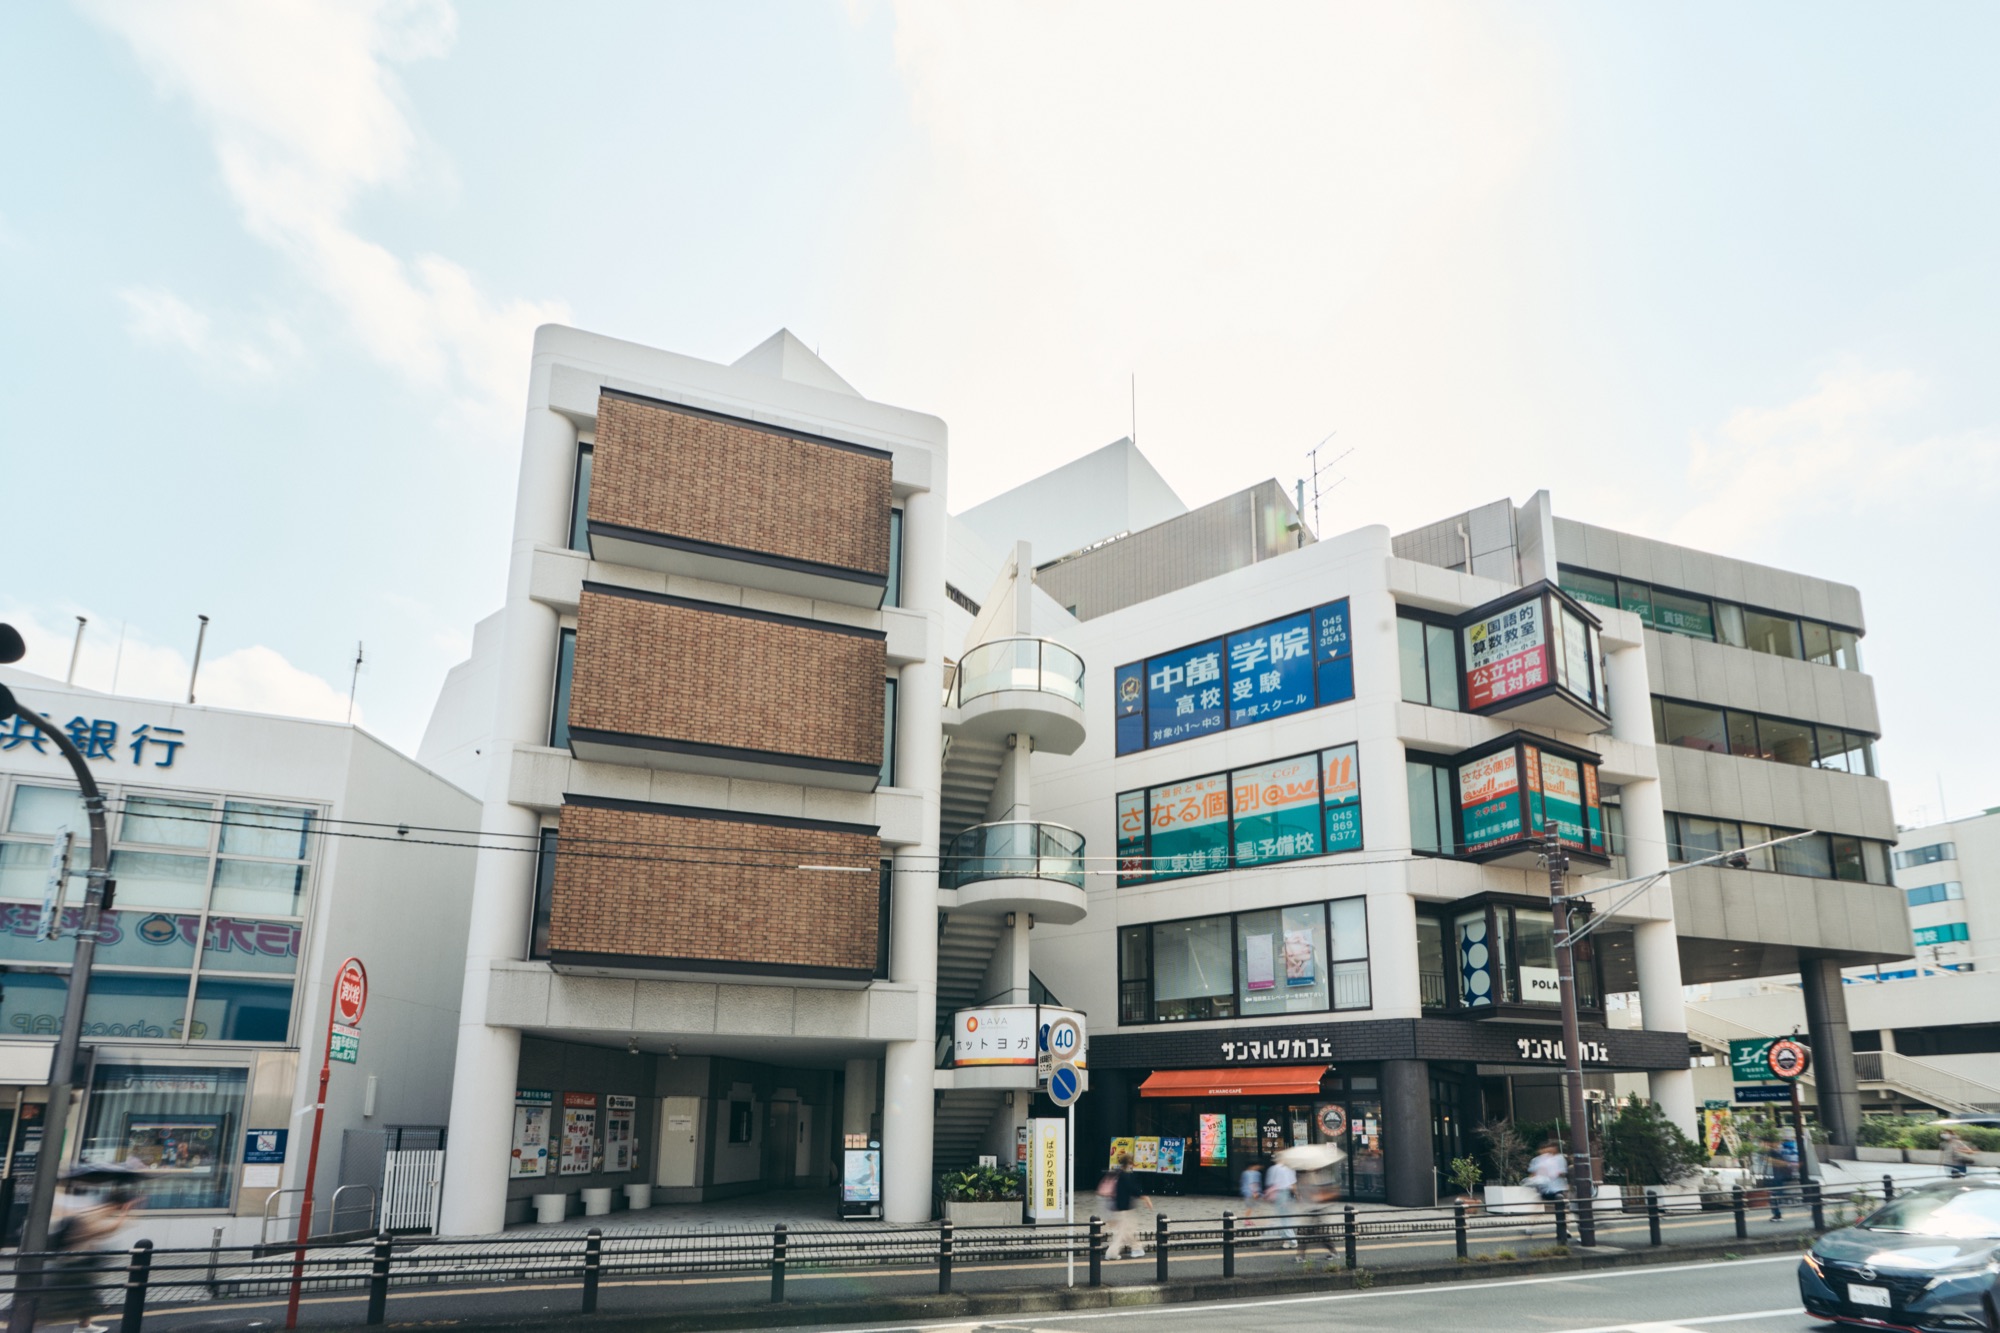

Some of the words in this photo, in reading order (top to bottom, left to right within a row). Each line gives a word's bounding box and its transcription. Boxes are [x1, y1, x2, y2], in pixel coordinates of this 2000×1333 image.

[1322, 615, 1342, 628] 045
[1322, 625, 1343, 637] 864
[1487, 606, 1534, 635] 国語的
[1320, 633, 1346, 647] 3543
[1473, 620, 1535, 656] 算数教室
[1150, 626, 1310, 694] 中萬学院
[1473, 650, 1541, 688] 公立中高
[1175, 671, 1282, 717] 高校受験
[1474, 668, 1542, 699] 一貫対策
[1235, 693, 1307, 720] 戸塚スクール
[1272, 764, 1300, 779] CGP
[1462, 755, 1516, 784] さなる個別
[1121, 783, 1260, 832] さなる個別
[1332, 810, 1353, 822] 045
[1330, 830, 1357, 842] 6377
[1332, 821, 1353, 832] 869
[1468, 832, 1519, 853] 045-869-6377
[340, 981, 361, 1005] 消火栓
[1532, 979, 1559, 990] POLA
[981, 1017, 1008, 1025] LAVA
[956, 1037, 1030, 1051] ホットヨガ
[1055, 1028, 1074, 1048] 40
[1221, 1037, 1333, 1061] サンマルクカフェ
[1517, 1038, 1609, 1061] サンマルカフェ
